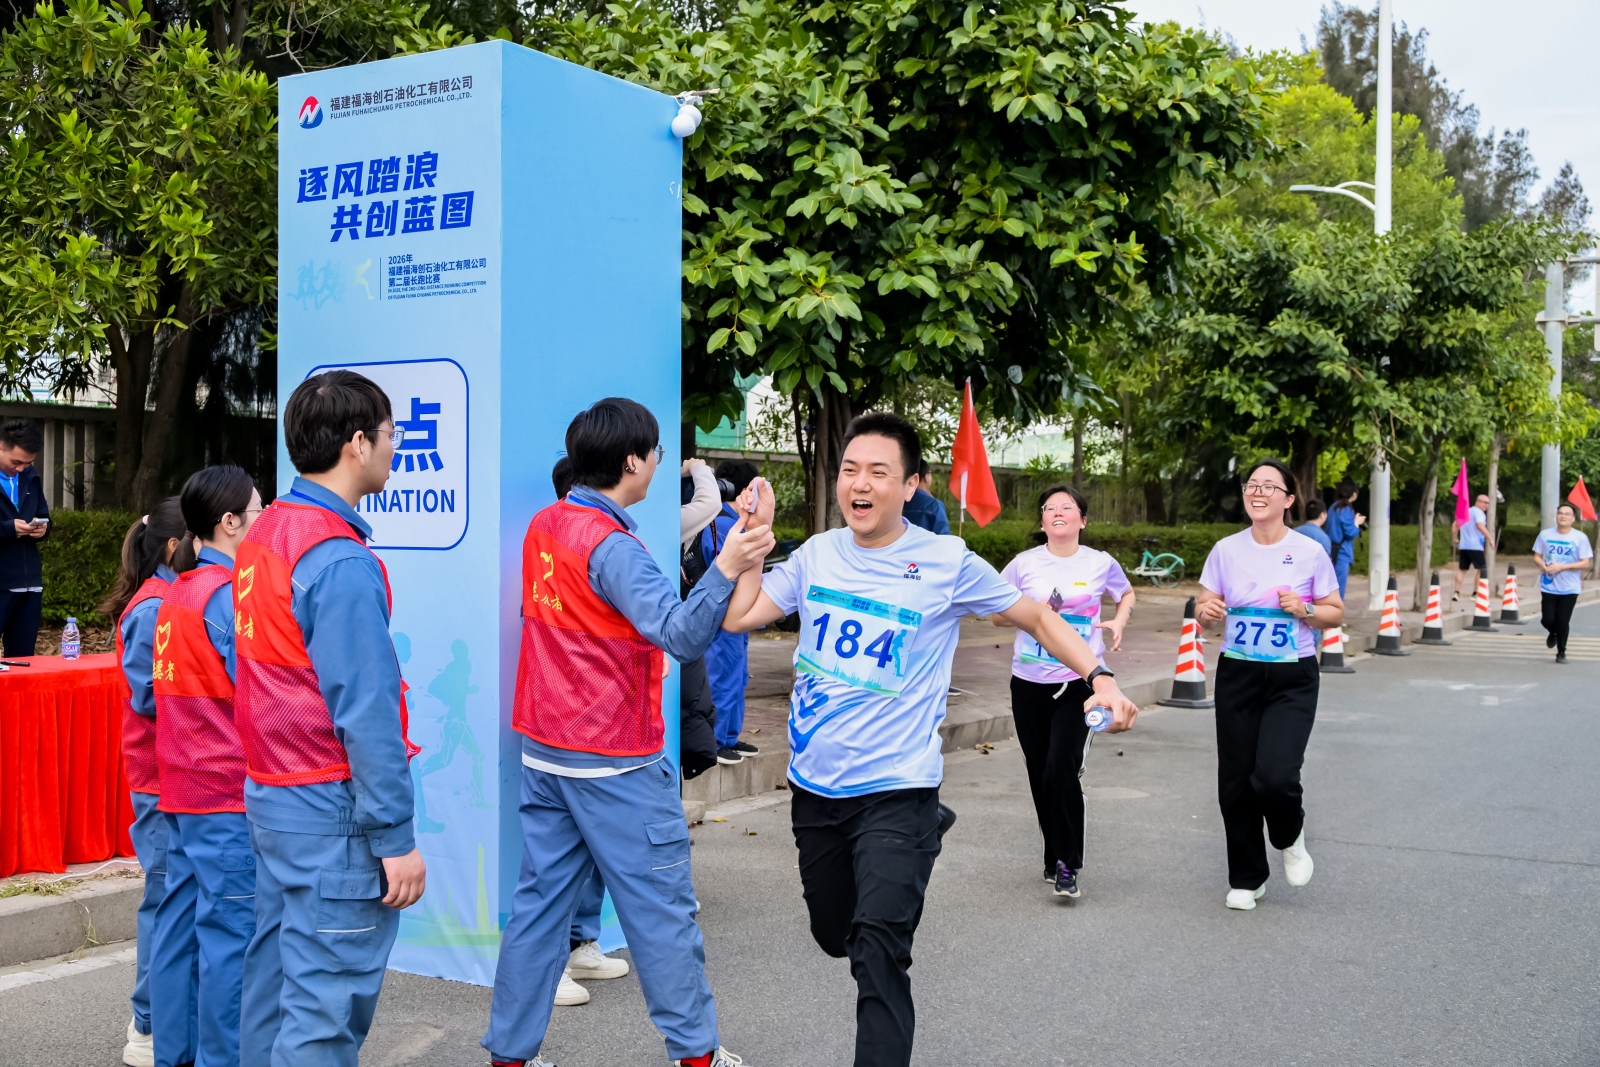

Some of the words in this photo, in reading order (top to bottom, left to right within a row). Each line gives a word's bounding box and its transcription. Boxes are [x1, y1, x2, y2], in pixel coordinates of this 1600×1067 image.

[330, 75, 473, 111] 福建福海创石油化工有限公司
[330, 110, 351, 120] FUJIAN
[351, 103, 394, 116] FUHAICHUANG
[394, 96, 445, 110] PETROCHEMICAL
[297, 151, 439, 203] 逐风踏浪
[330, 190, 475, 242] 共创蓝图
[388, 253, 413, 265] 2026年
[388, 258, 487, 276] 福建福海创石油化工有限公司
[388, 274, 440, 287] 第二届长跑比赛
[356, 489, 455, 513] INATION
[1549, 545, 1571, 556] 202
[812, 613, 895, 668] 184
[1234, 620, 1289, 648] 275
